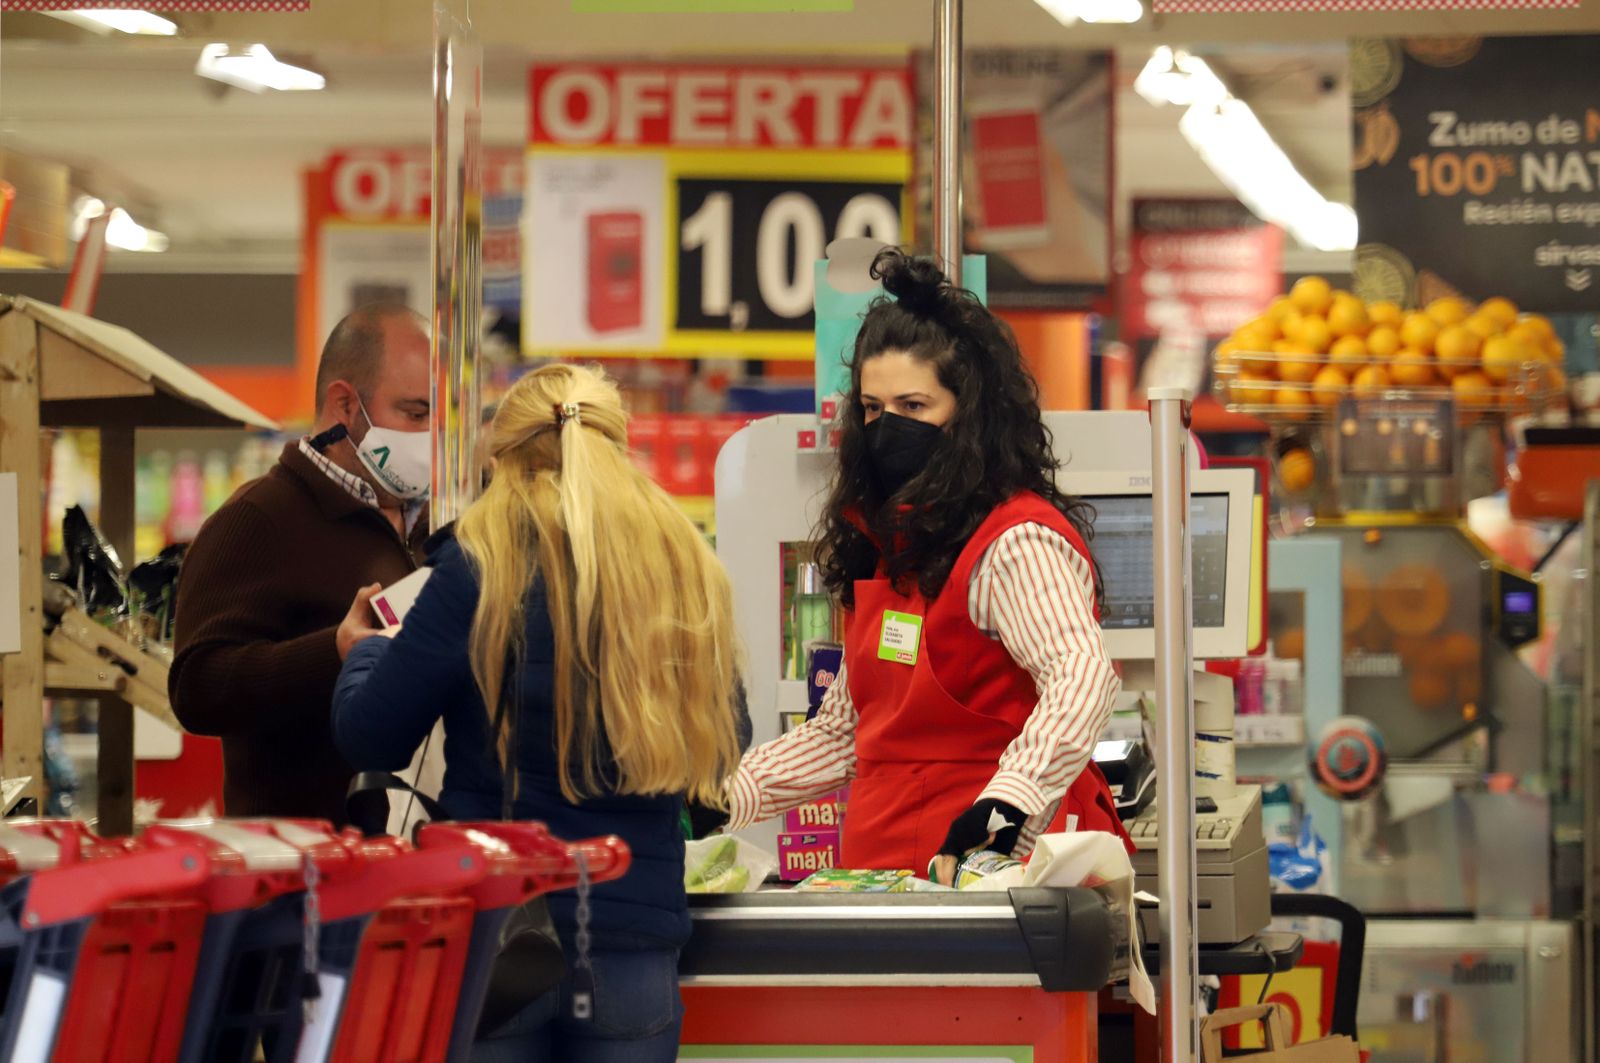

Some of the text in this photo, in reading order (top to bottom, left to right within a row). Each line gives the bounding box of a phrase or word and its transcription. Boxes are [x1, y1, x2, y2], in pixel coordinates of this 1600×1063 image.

[539, 71, 910, 149] OFERTA
[1428, 111, 1532, 147] Zumo
[1536, 114, 1581, 145] de
[1463, 198, 1553, 225] Recién
[786, 845, 834, 870] maxi
